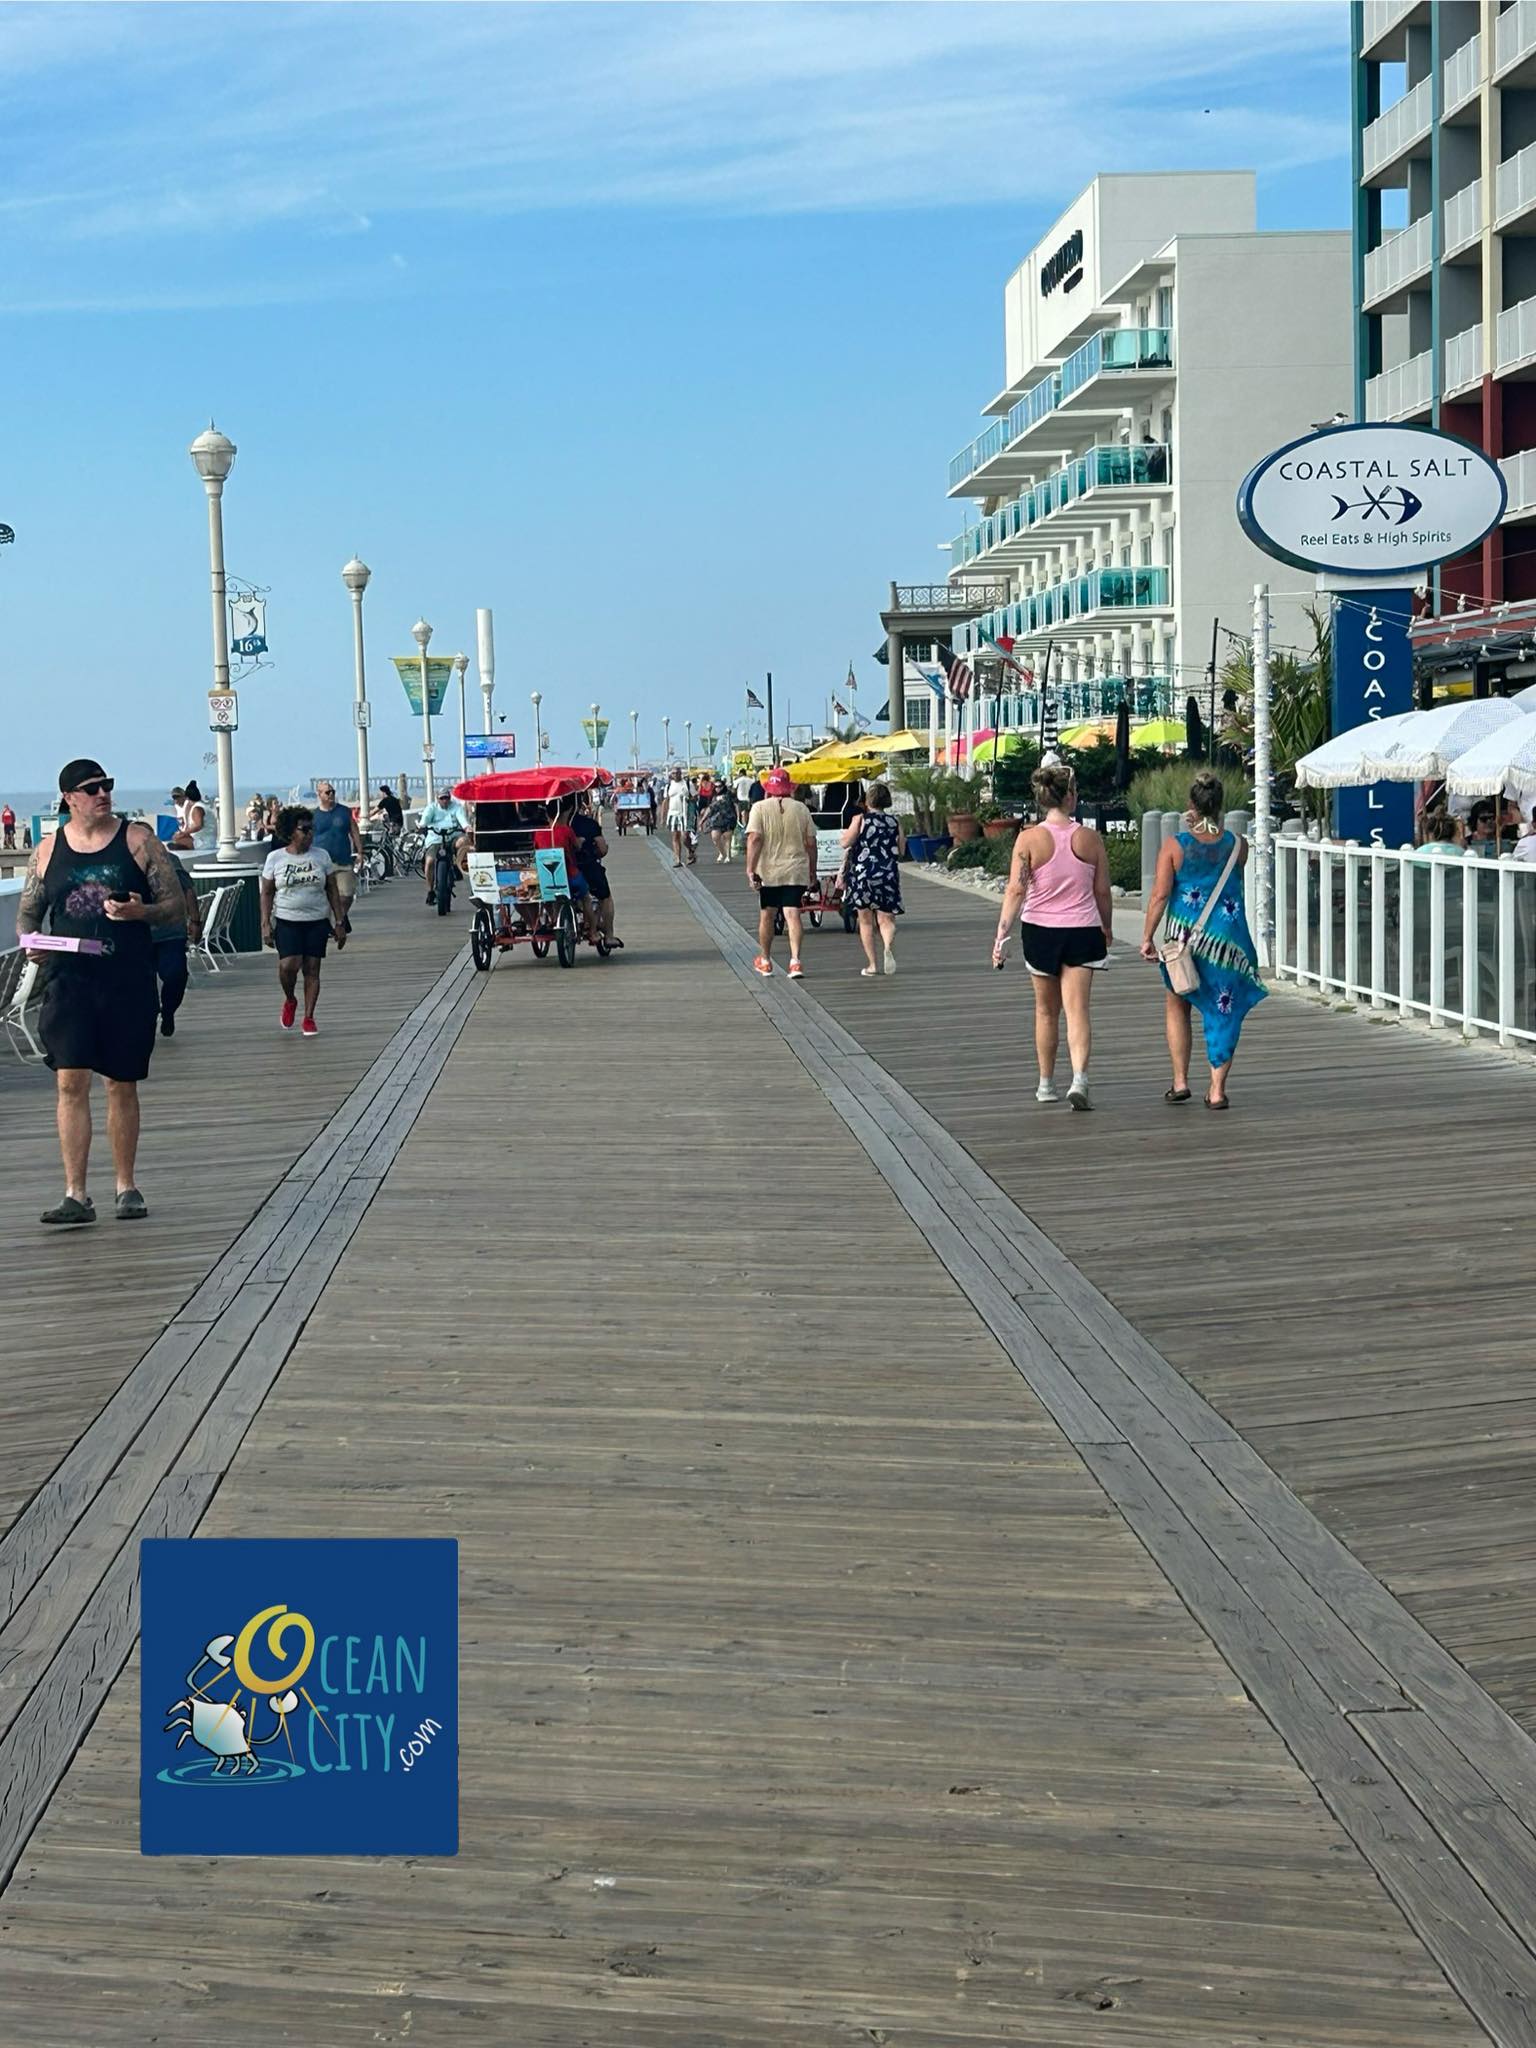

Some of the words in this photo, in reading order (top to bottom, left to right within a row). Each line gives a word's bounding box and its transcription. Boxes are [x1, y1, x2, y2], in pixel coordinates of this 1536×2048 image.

[1279, 460, 1398, 481] COASTAL
[1410, 458, 1473, 477] SALT
[1300, 533, 1328, 546] Reel
[1332, 532, 1360, 545] Eats
[1363, 532, 1373, 543] &
[1377, 531, 1408, 546] High
[1412, 530, 1452, 546] Spirits
